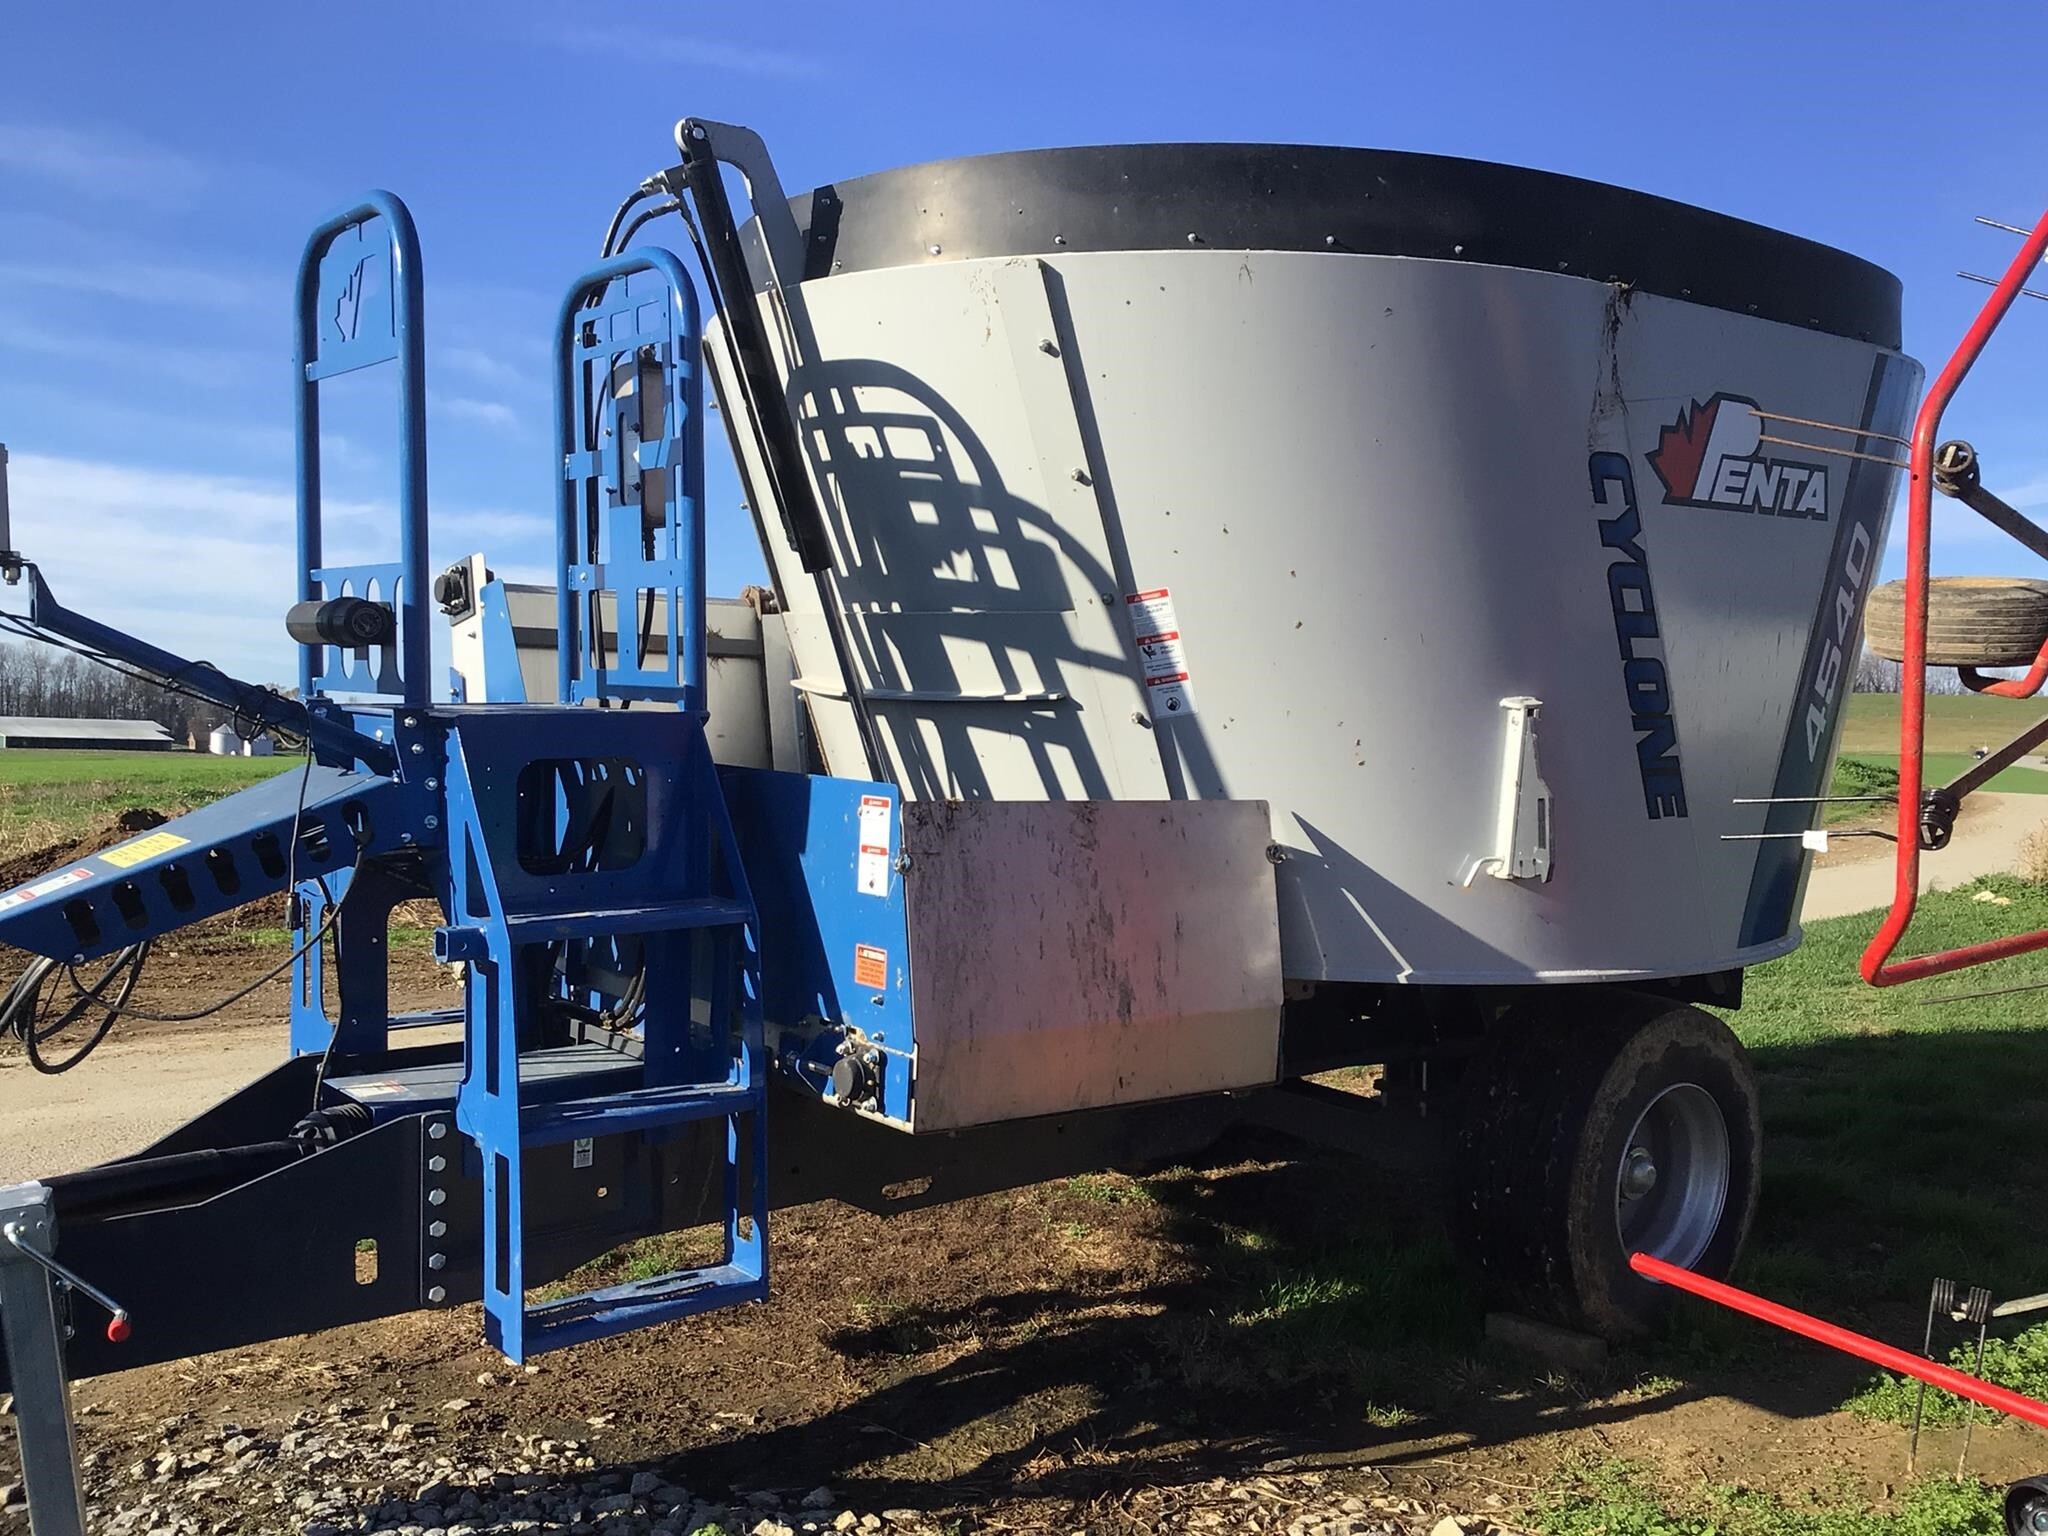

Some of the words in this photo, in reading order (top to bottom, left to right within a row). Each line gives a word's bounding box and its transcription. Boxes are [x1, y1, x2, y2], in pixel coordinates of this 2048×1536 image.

[1689, 396, 1828, 515] PENTA
[1586, 449, 1689, 819] CYCLONE
[1804, 519, 1871, 763] 4540
